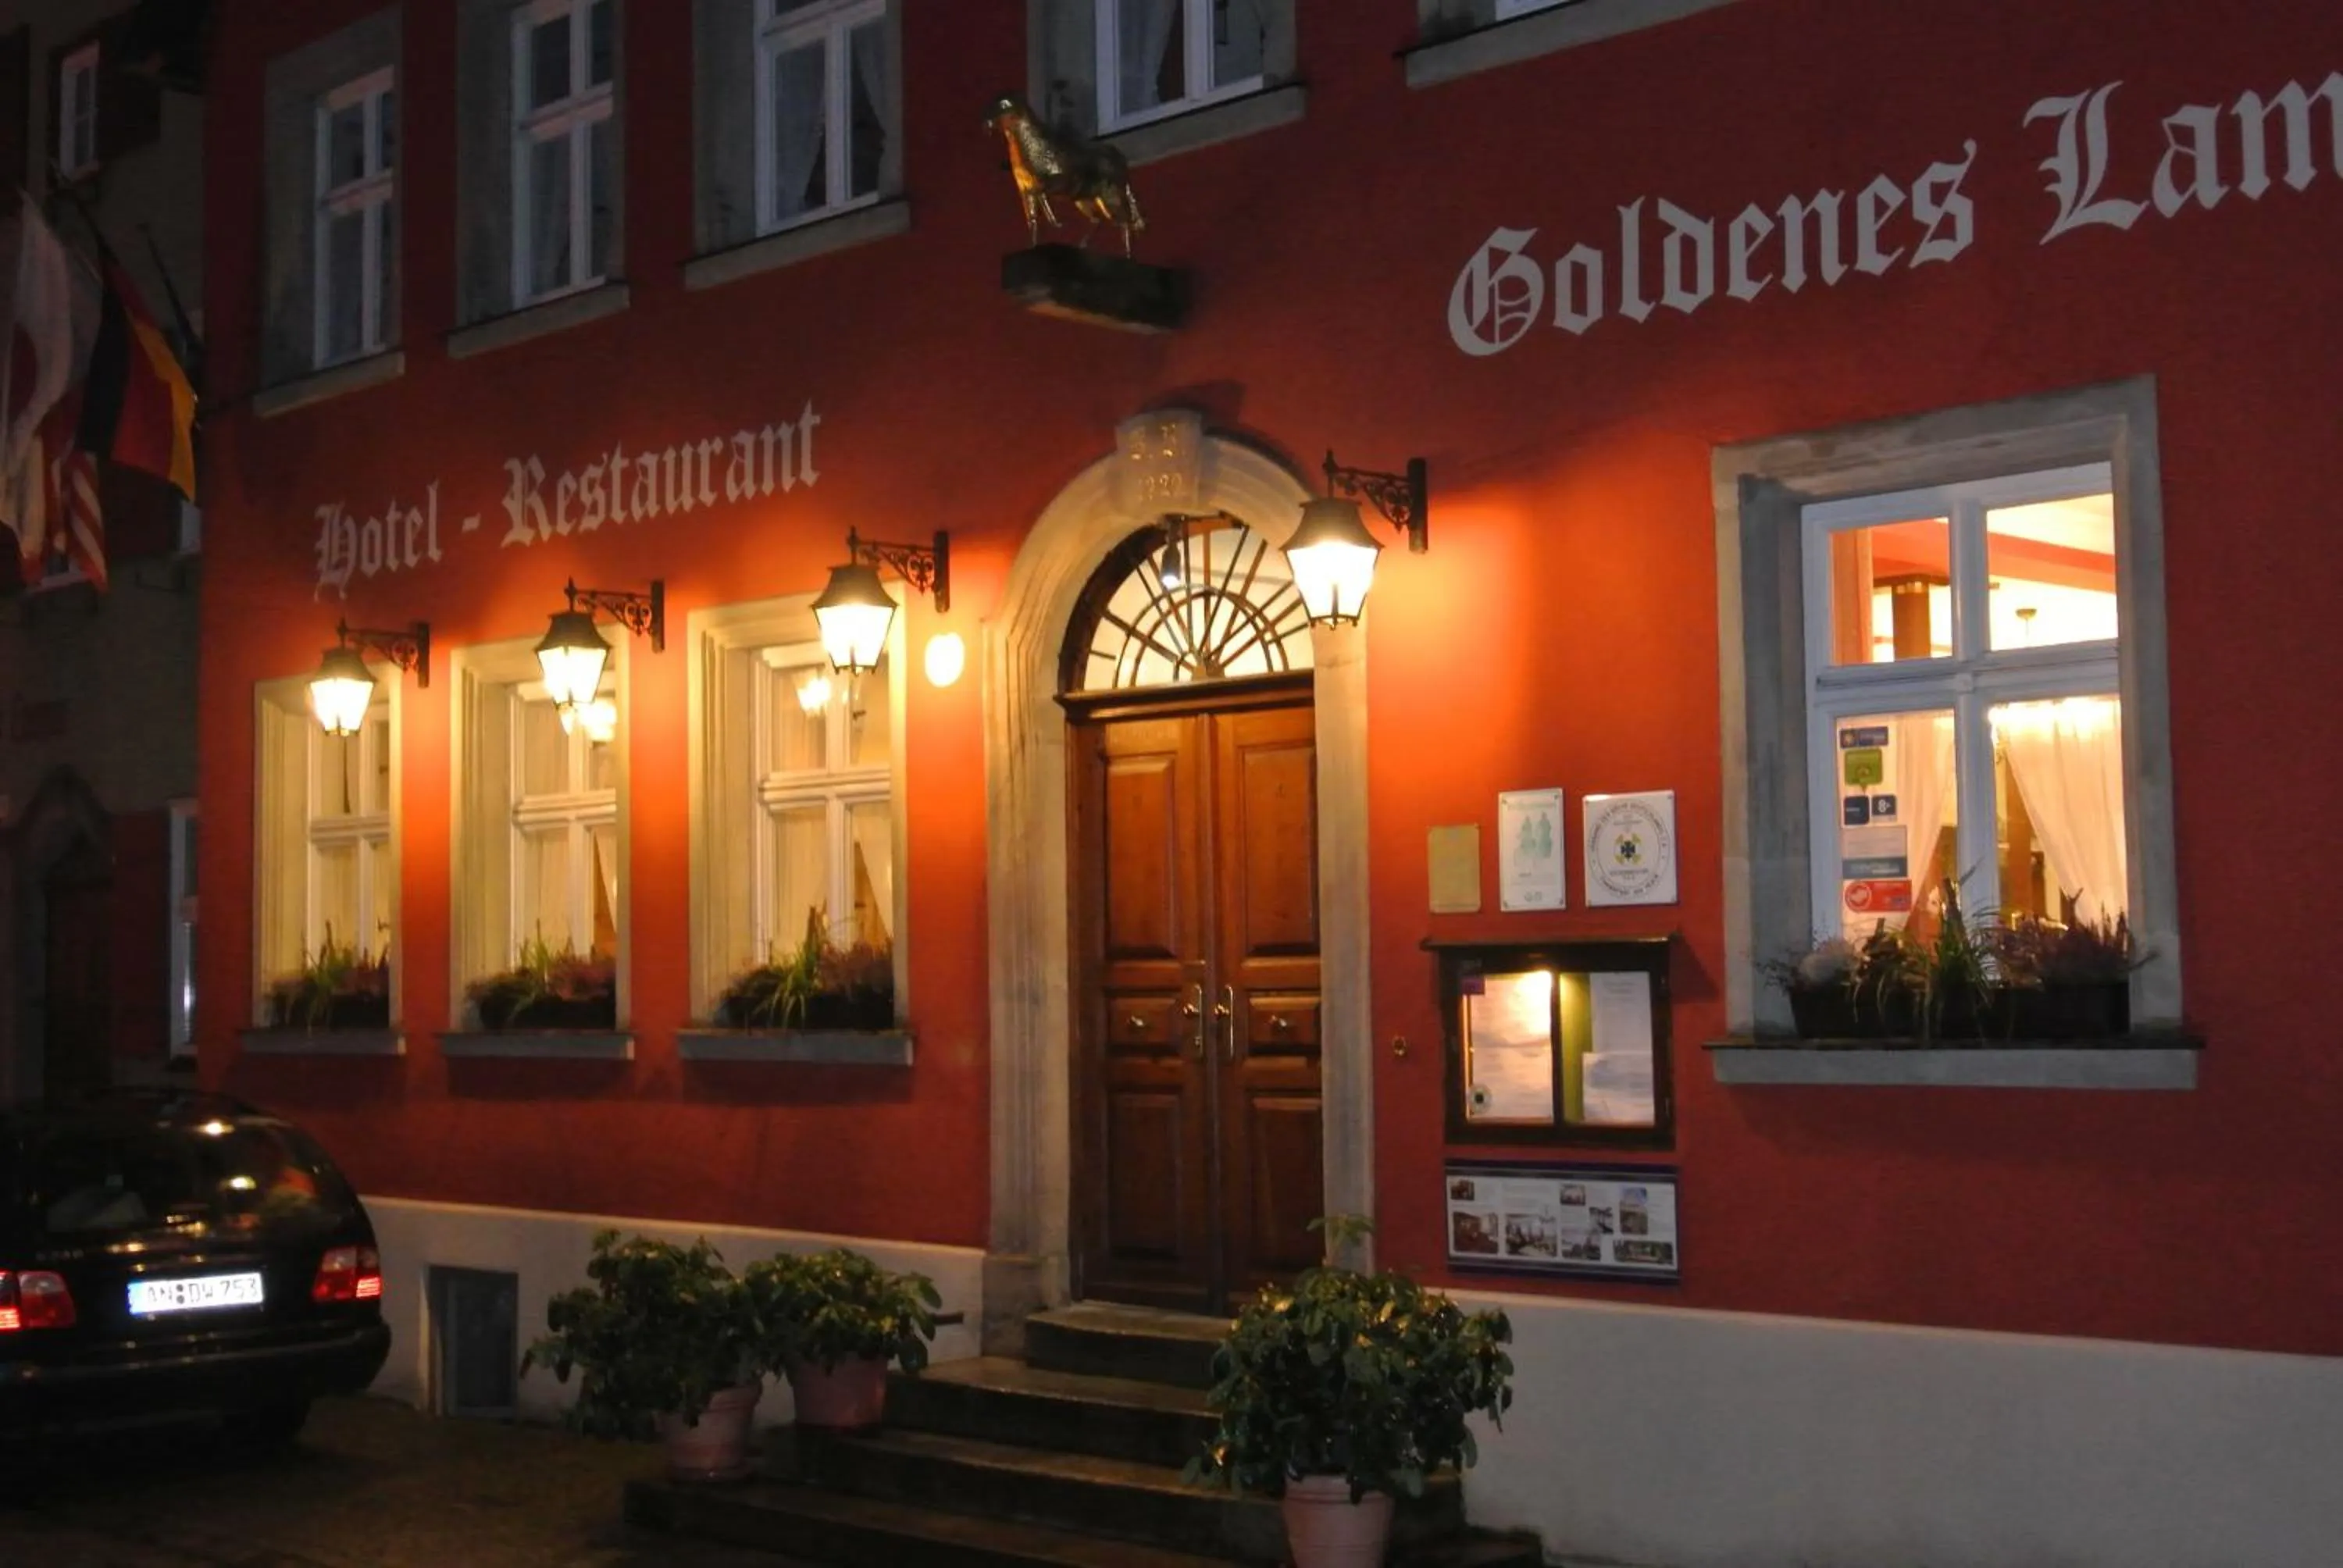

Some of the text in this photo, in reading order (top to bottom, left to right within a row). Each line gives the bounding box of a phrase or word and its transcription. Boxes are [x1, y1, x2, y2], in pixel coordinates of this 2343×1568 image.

[1447, 139, 1977, 358] Goldenes
[314, 479, 442, 601] Hotel
[501, 398, 821, 548] Restaurant
